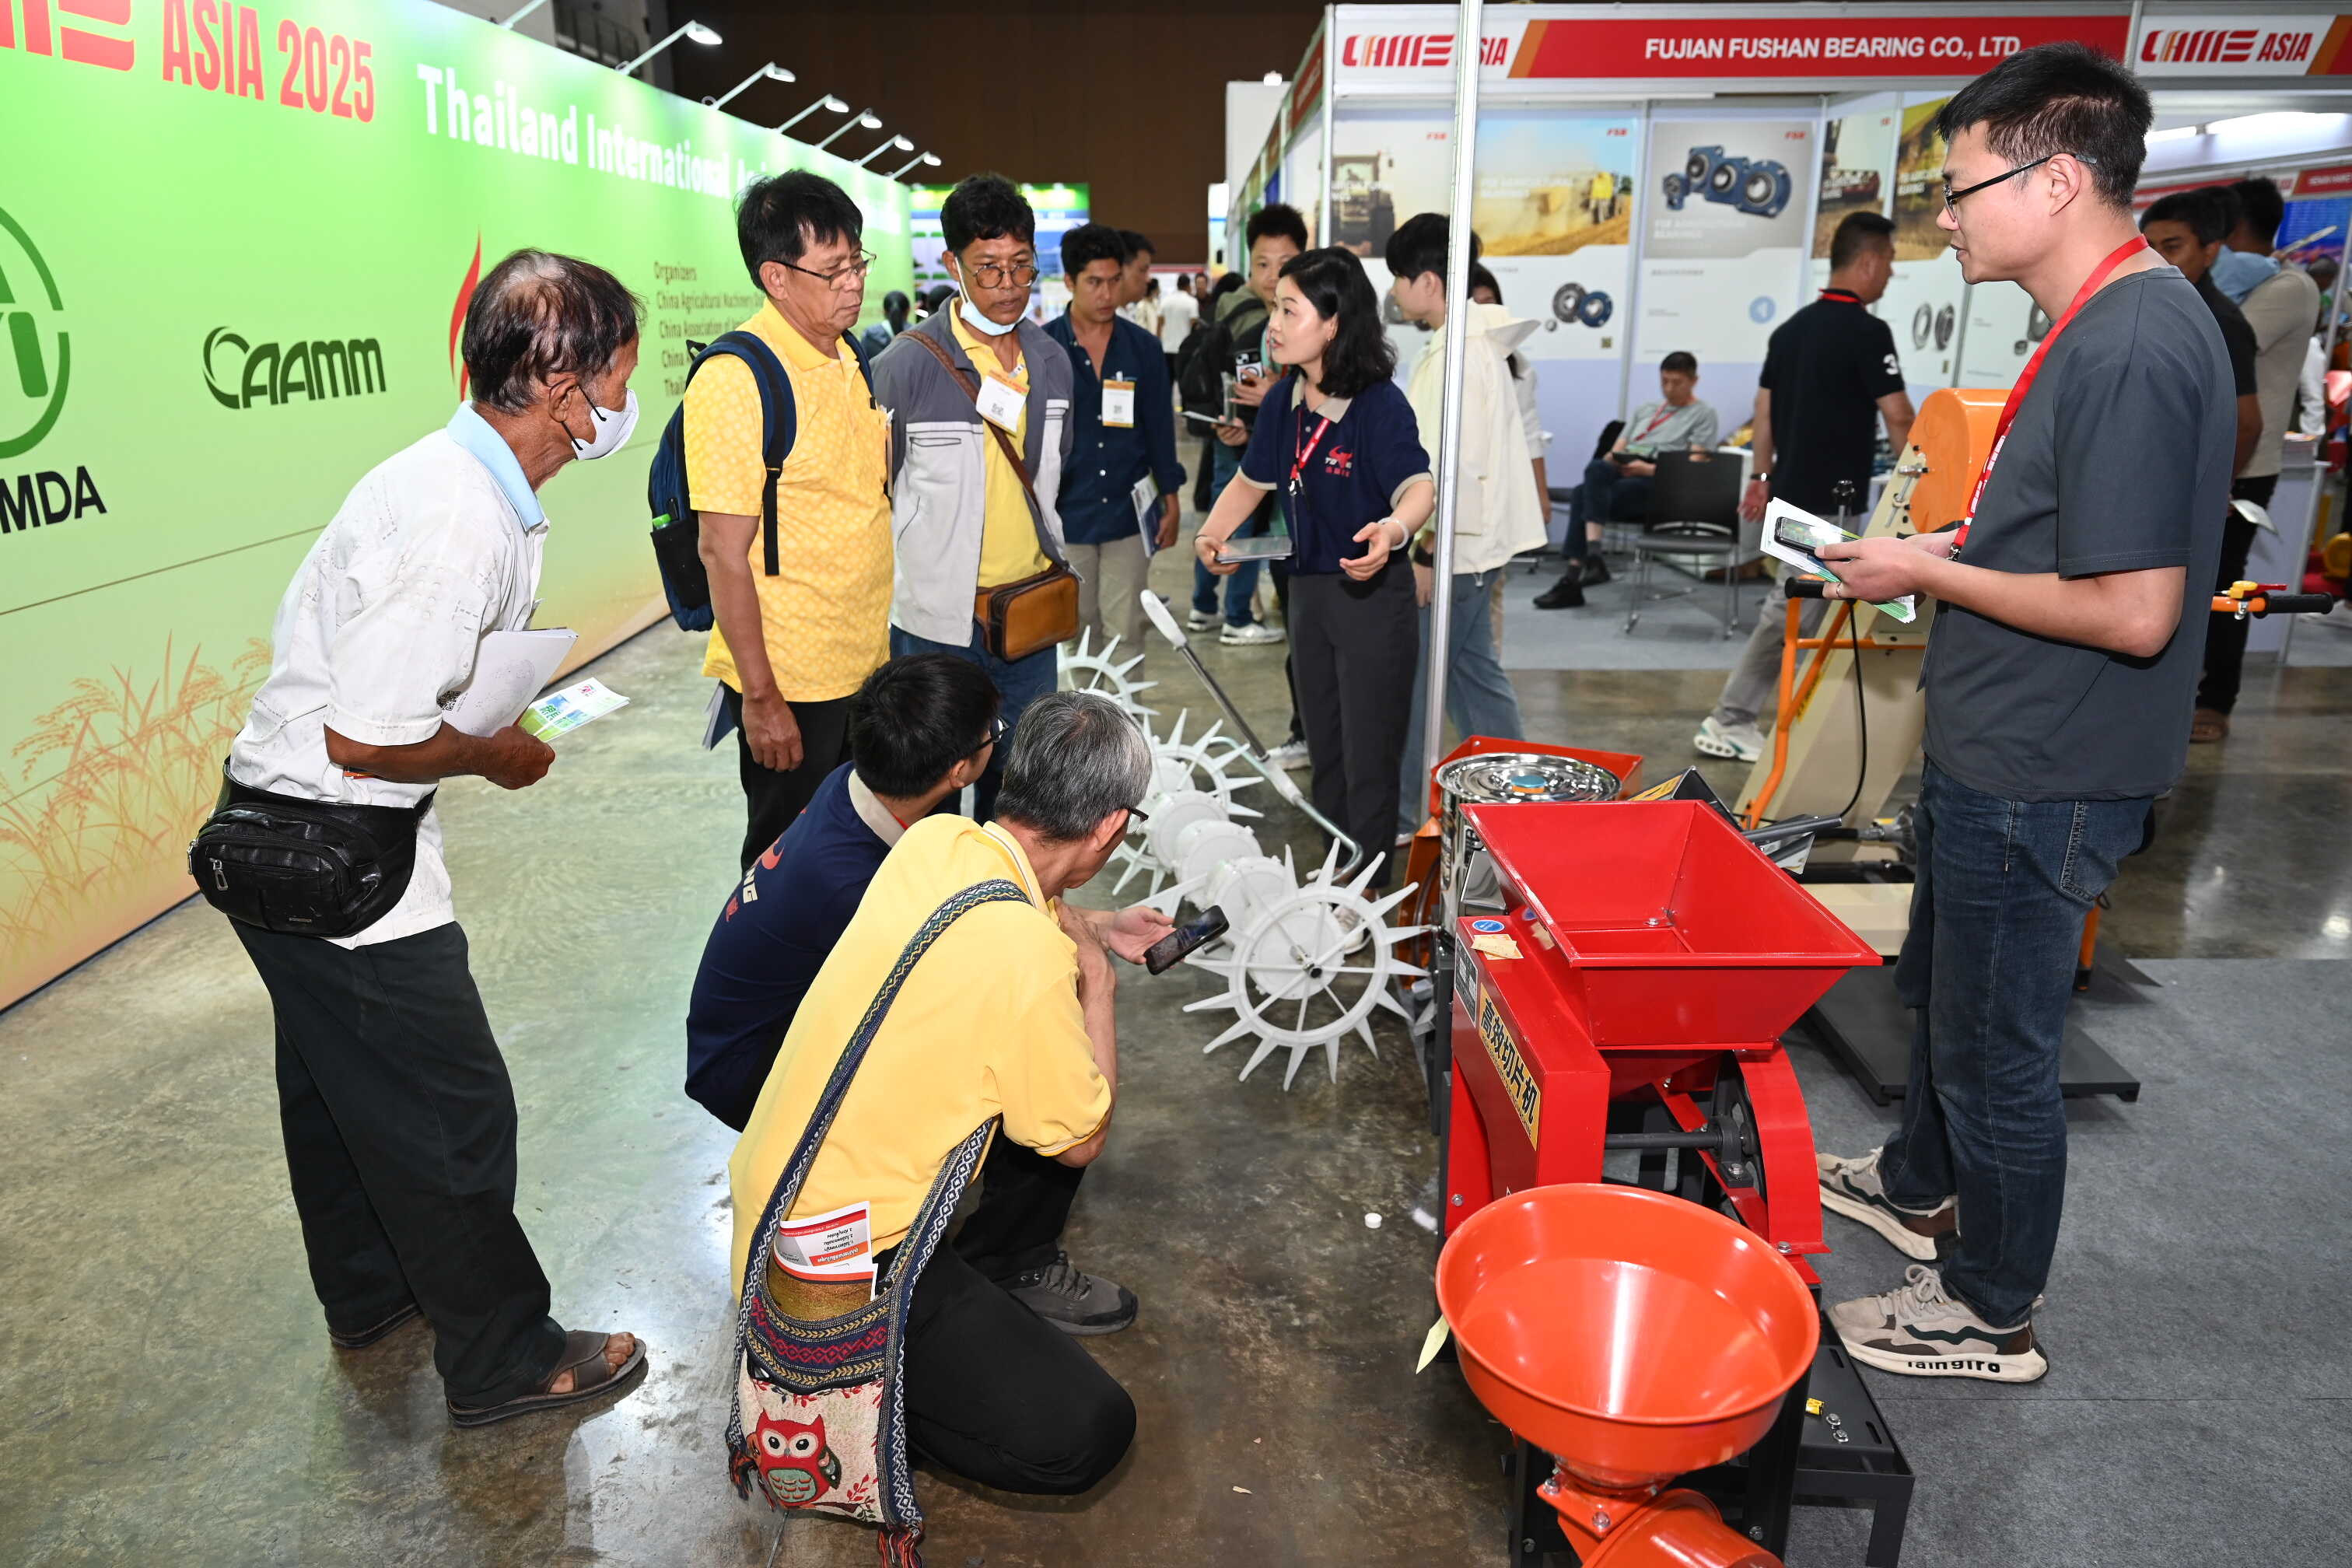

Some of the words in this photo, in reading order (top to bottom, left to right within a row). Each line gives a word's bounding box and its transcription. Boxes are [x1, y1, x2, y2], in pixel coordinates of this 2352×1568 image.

[1645, 38, 1724, 58] FUJIAN
[1727, 38, 1820, 58] FUSHAN
[1824, 37, 1925, 58] BEARING
[1929, 37, 1973, 60] CO.,
[2257, 33, 2314, 61] ASIA
[163, 0, 264, 100] ASIA
[278, 19, 374, 123] 2025
[417, 64, 579, 165] Thailand
[587, 114, 730, 199] International
[654, 261, 697, 285] Organizers
[657, 292, 679, 310] China
[682, 292, 720, 313] Agricultural
[660, 320, 681, 339] China
[203, 326, 387, 410] CAAMM
[662, 349, 684, 368] China
[1481, 998, 1538, 1125] 高效切片机
